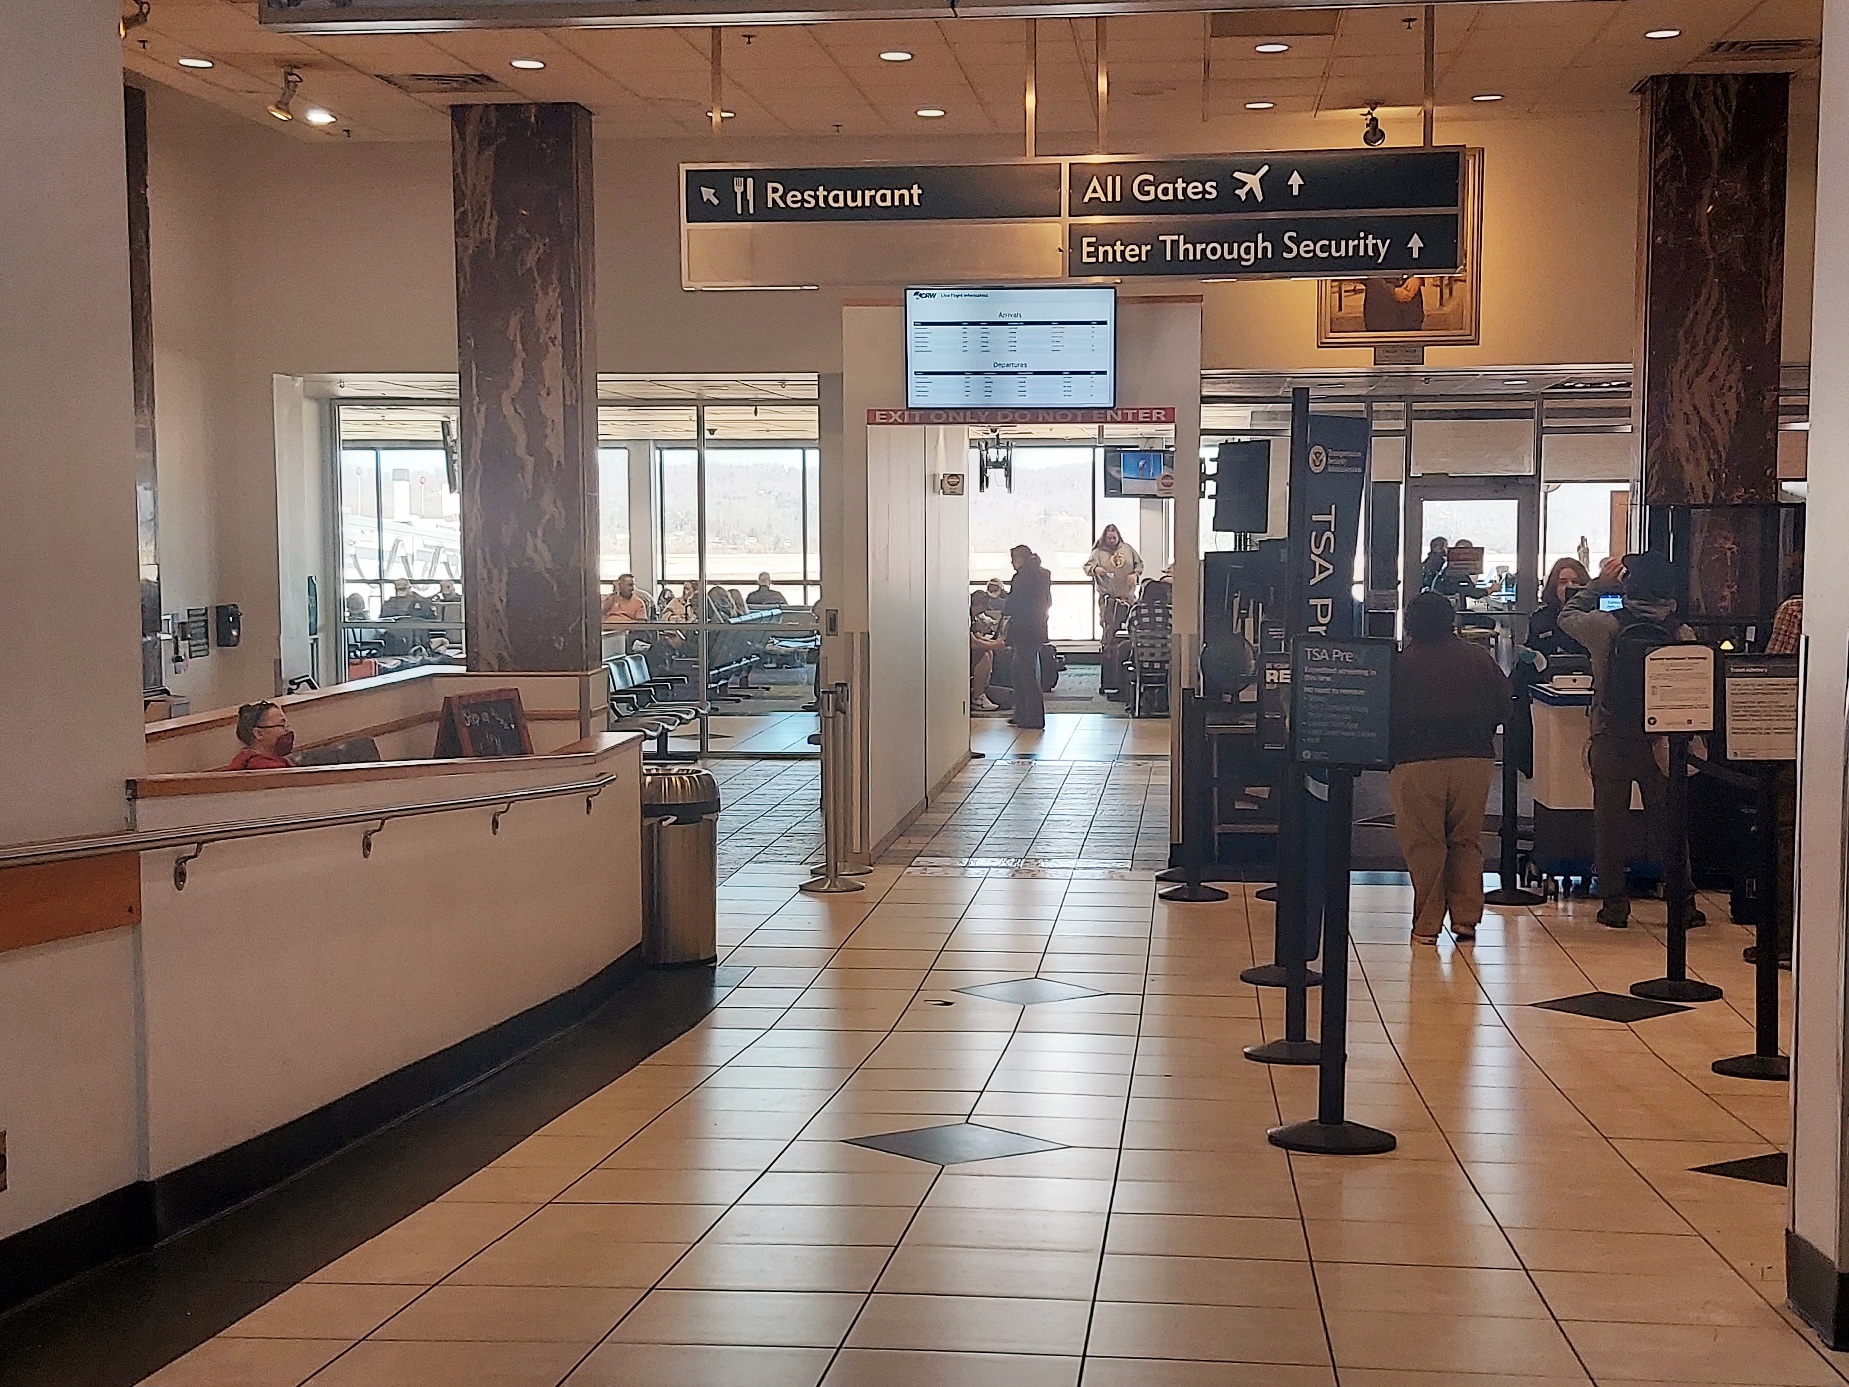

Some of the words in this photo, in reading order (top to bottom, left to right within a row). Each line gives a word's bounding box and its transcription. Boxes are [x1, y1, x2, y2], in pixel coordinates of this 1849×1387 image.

[766, 183, 922, 208] Restaurant
[1084, 177, 1122, 203] All
[1133, 175, 1218, 201] Gates
[1081, 237, 1151, 263] Enter
[1160, 234, 1273, 265] Through
[1283, 231, 1391, 262] Security
[993, 361, 1028, 369] Departures
[876, 410, 923, 423] EXIT
[930, 410, 989, 422] ONLY
[998, 410, 1031, 422] DO
[1039, 410, 1084, 421] NOT
[1094, 409, 1167, 421] ENTER
[1309, 504, 1337, 586] TSA
[1304, 648, 1329, 661] TSA
[1332, 649, 1354, 662] Pre
